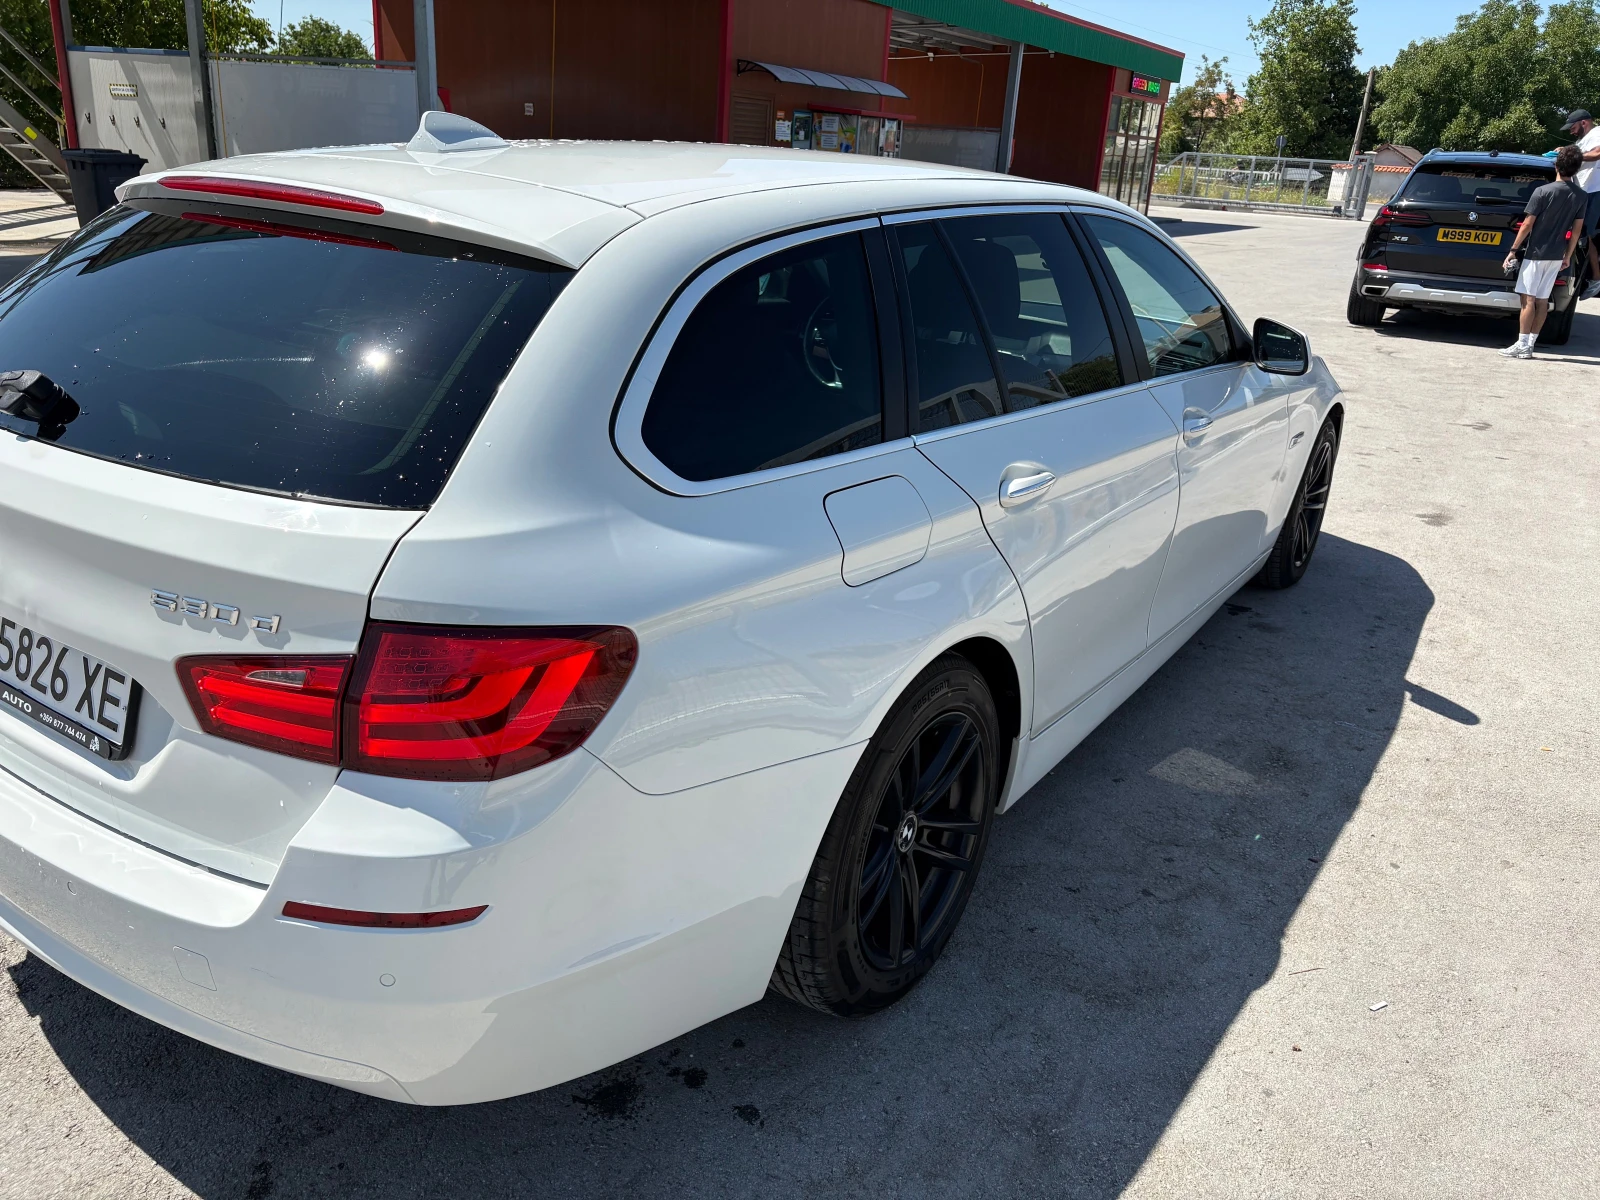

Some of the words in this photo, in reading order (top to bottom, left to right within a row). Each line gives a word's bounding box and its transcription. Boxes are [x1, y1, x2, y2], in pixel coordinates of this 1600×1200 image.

[1474, 231, 1497, 243] KOV
[150, 588, 240, 626] 530
[250, 614, 281, 635] d
[0, 616, 69, 702] 5826
[75, 656, 126, 733] XE
[2, 690, 32, 713] AUTO
[39, 712, 53, 724] +359
[64, 724, 75, 736] 744
[75, 731, 86, 743] 474
